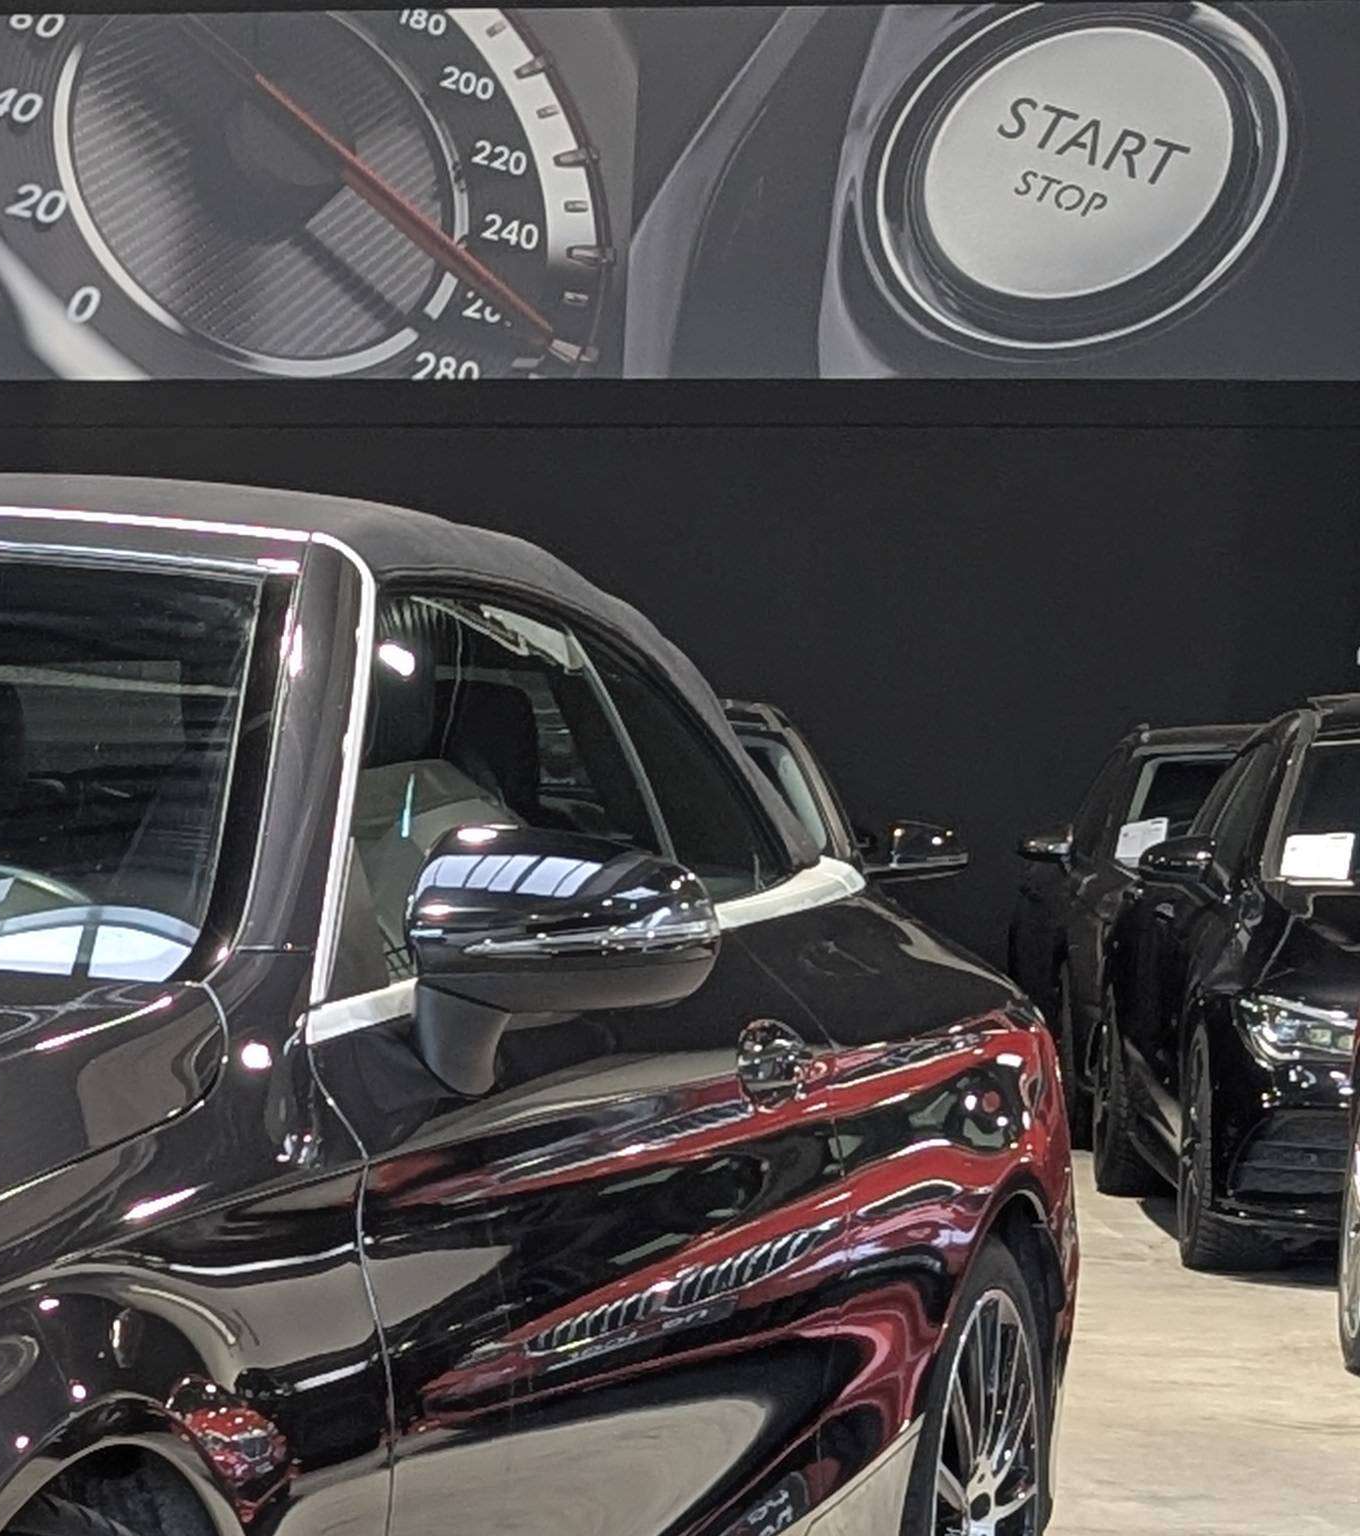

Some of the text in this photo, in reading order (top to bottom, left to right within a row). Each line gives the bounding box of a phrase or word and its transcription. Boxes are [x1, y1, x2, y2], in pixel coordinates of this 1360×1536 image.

[440, 66, 495, 100] 200
[471, 140, 527, 176] 220
[997, 97, 1191, 185] START
[5, 184, 67, 223] 20
[1013, 170, 1108, 217] STOP
[481, 213, 539, 250] 240
[67, 286, 101, 323] 0
